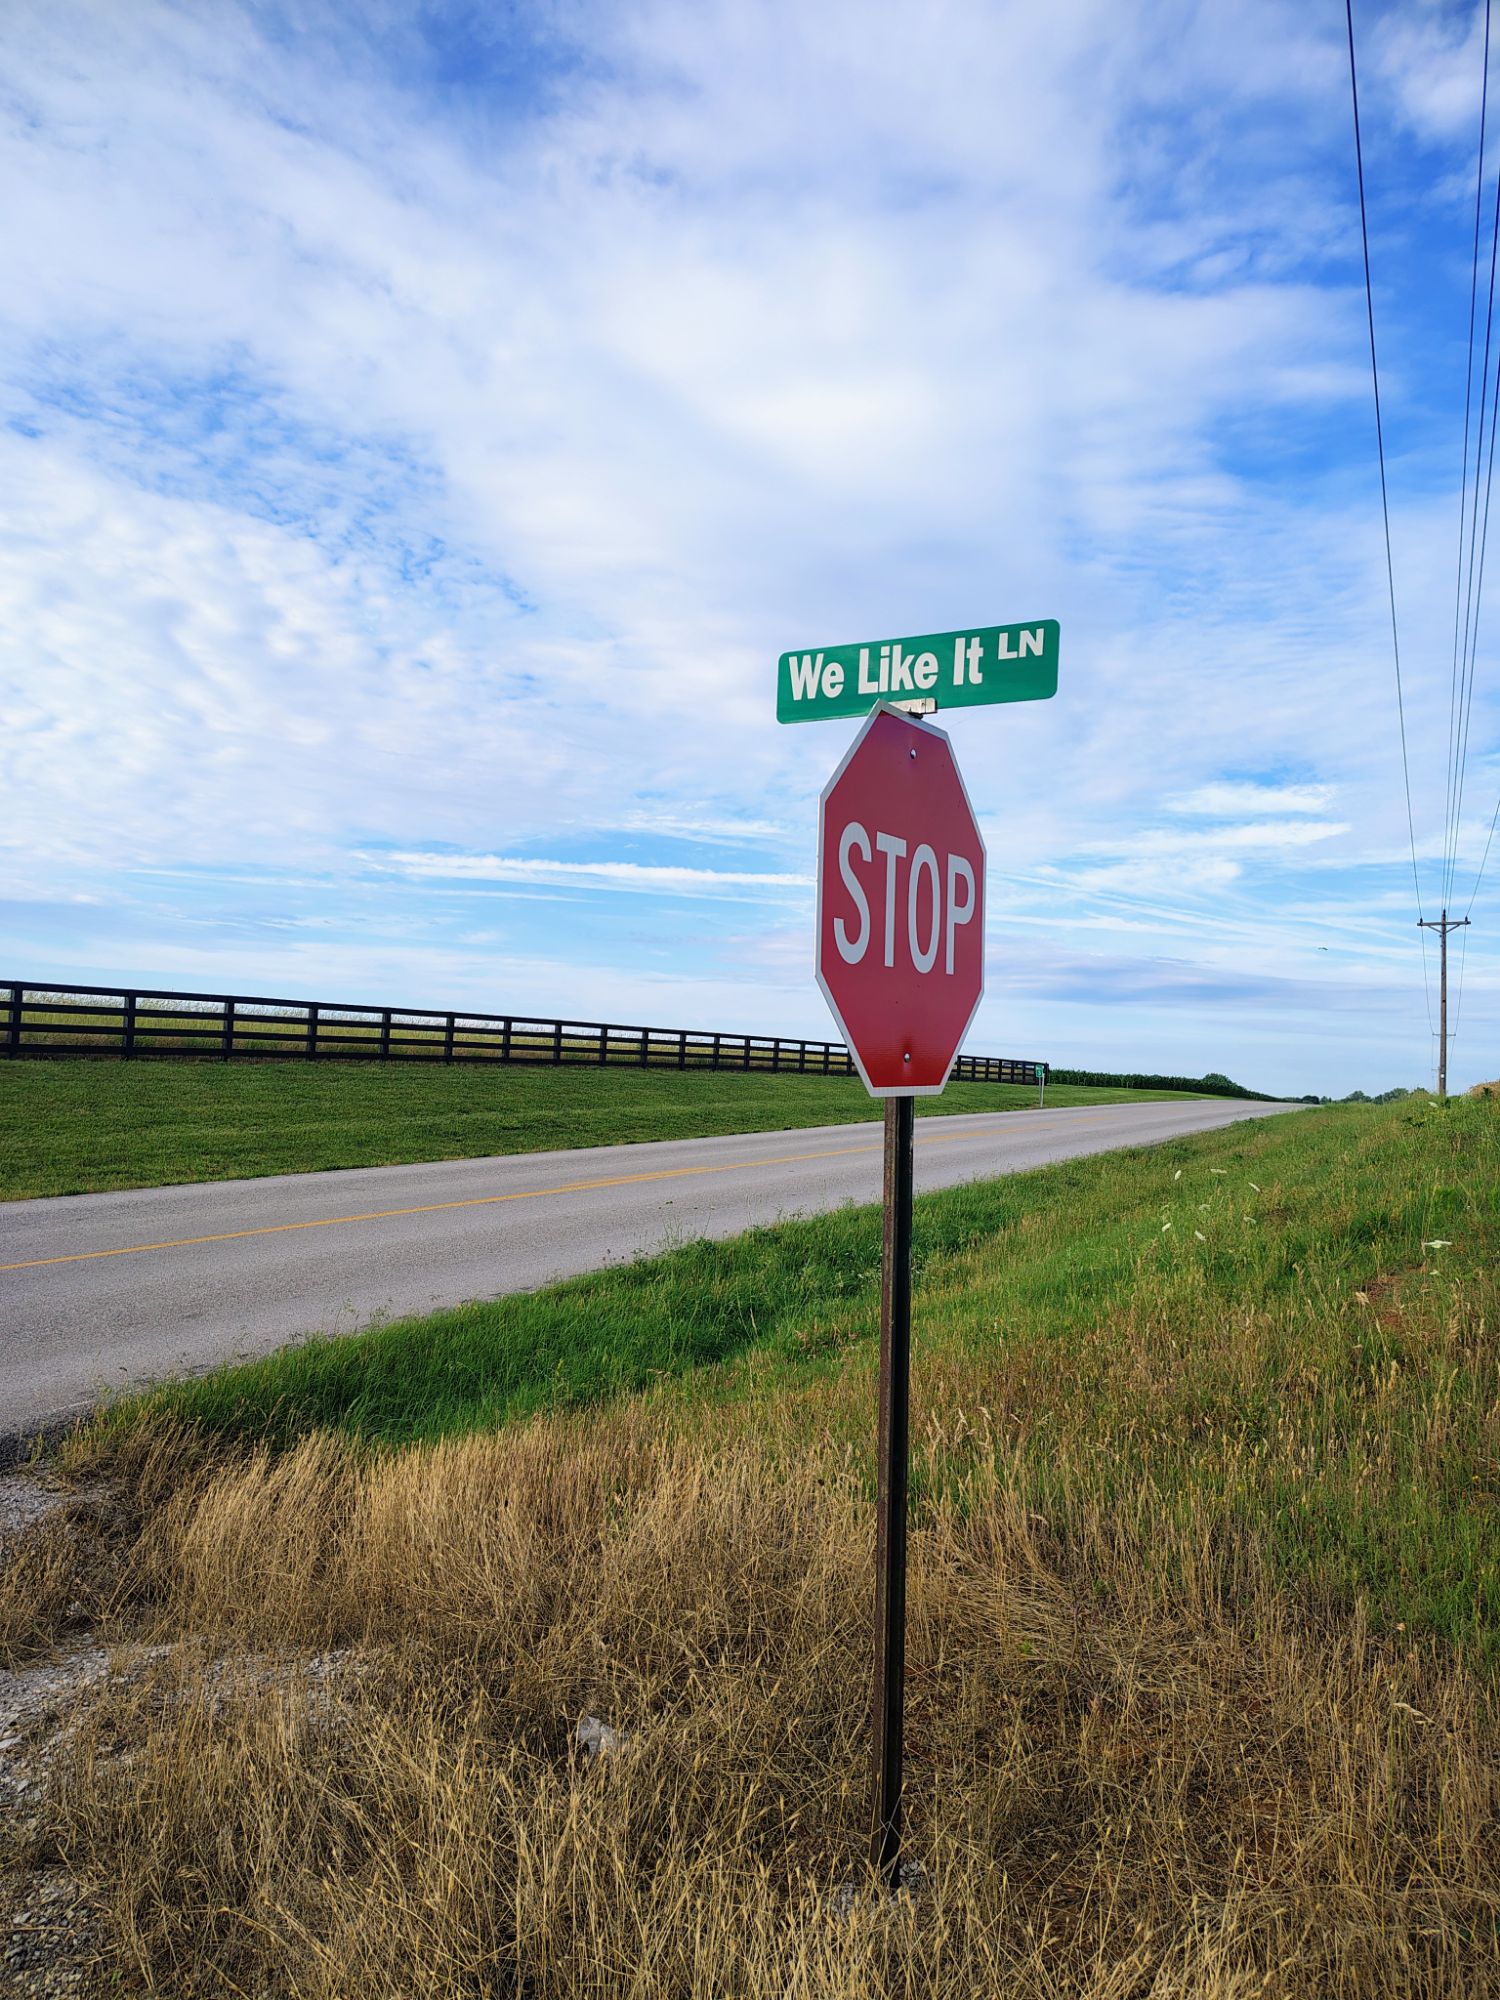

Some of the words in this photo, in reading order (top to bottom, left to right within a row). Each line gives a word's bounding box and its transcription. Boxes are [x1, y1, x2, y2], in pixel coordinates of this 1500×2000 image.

[789, 653, 845, 701] We
[858, 644, 939, 695] Like
[953, 636, 984, 686] It
[998, 628, 1045, 660] LN
[833, 821, 976, 975] STOP
